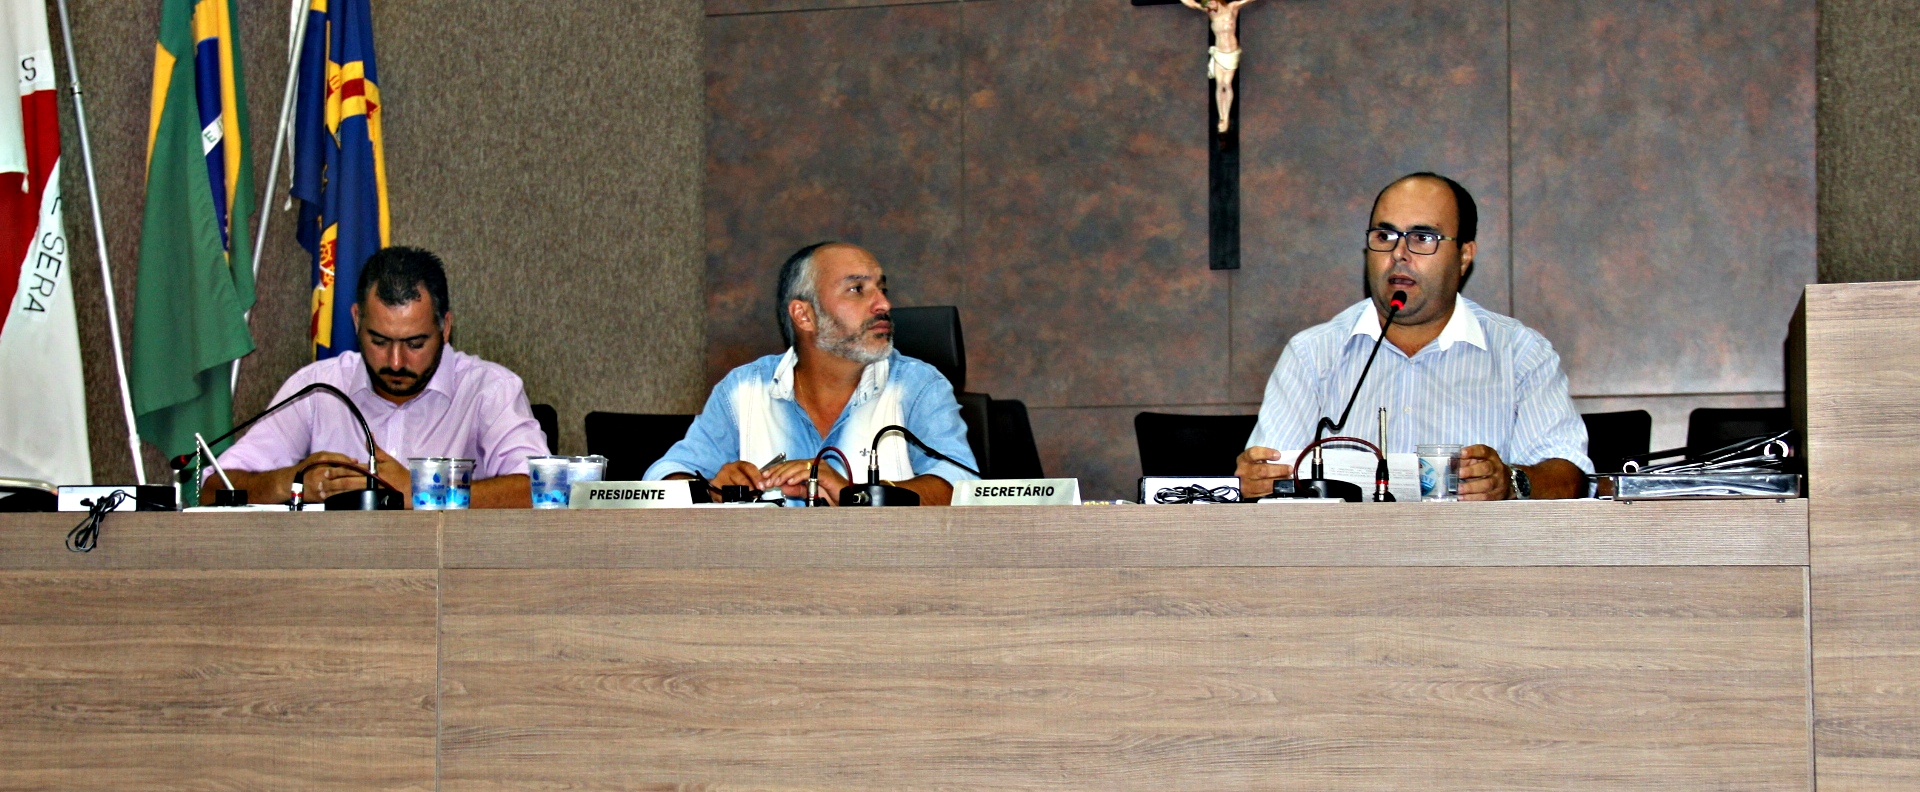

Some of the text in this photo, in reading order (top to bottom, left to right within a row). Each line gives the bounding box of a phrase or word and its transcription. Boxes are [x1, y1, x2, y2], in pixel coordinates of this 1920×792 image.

[19, 57, 36, 83] S
[24, 232, 65, 312] SERA
[589, 489, 665, 500] PRESIDENTE
[974, 484, 1055, 497] SECRETÁRIO
